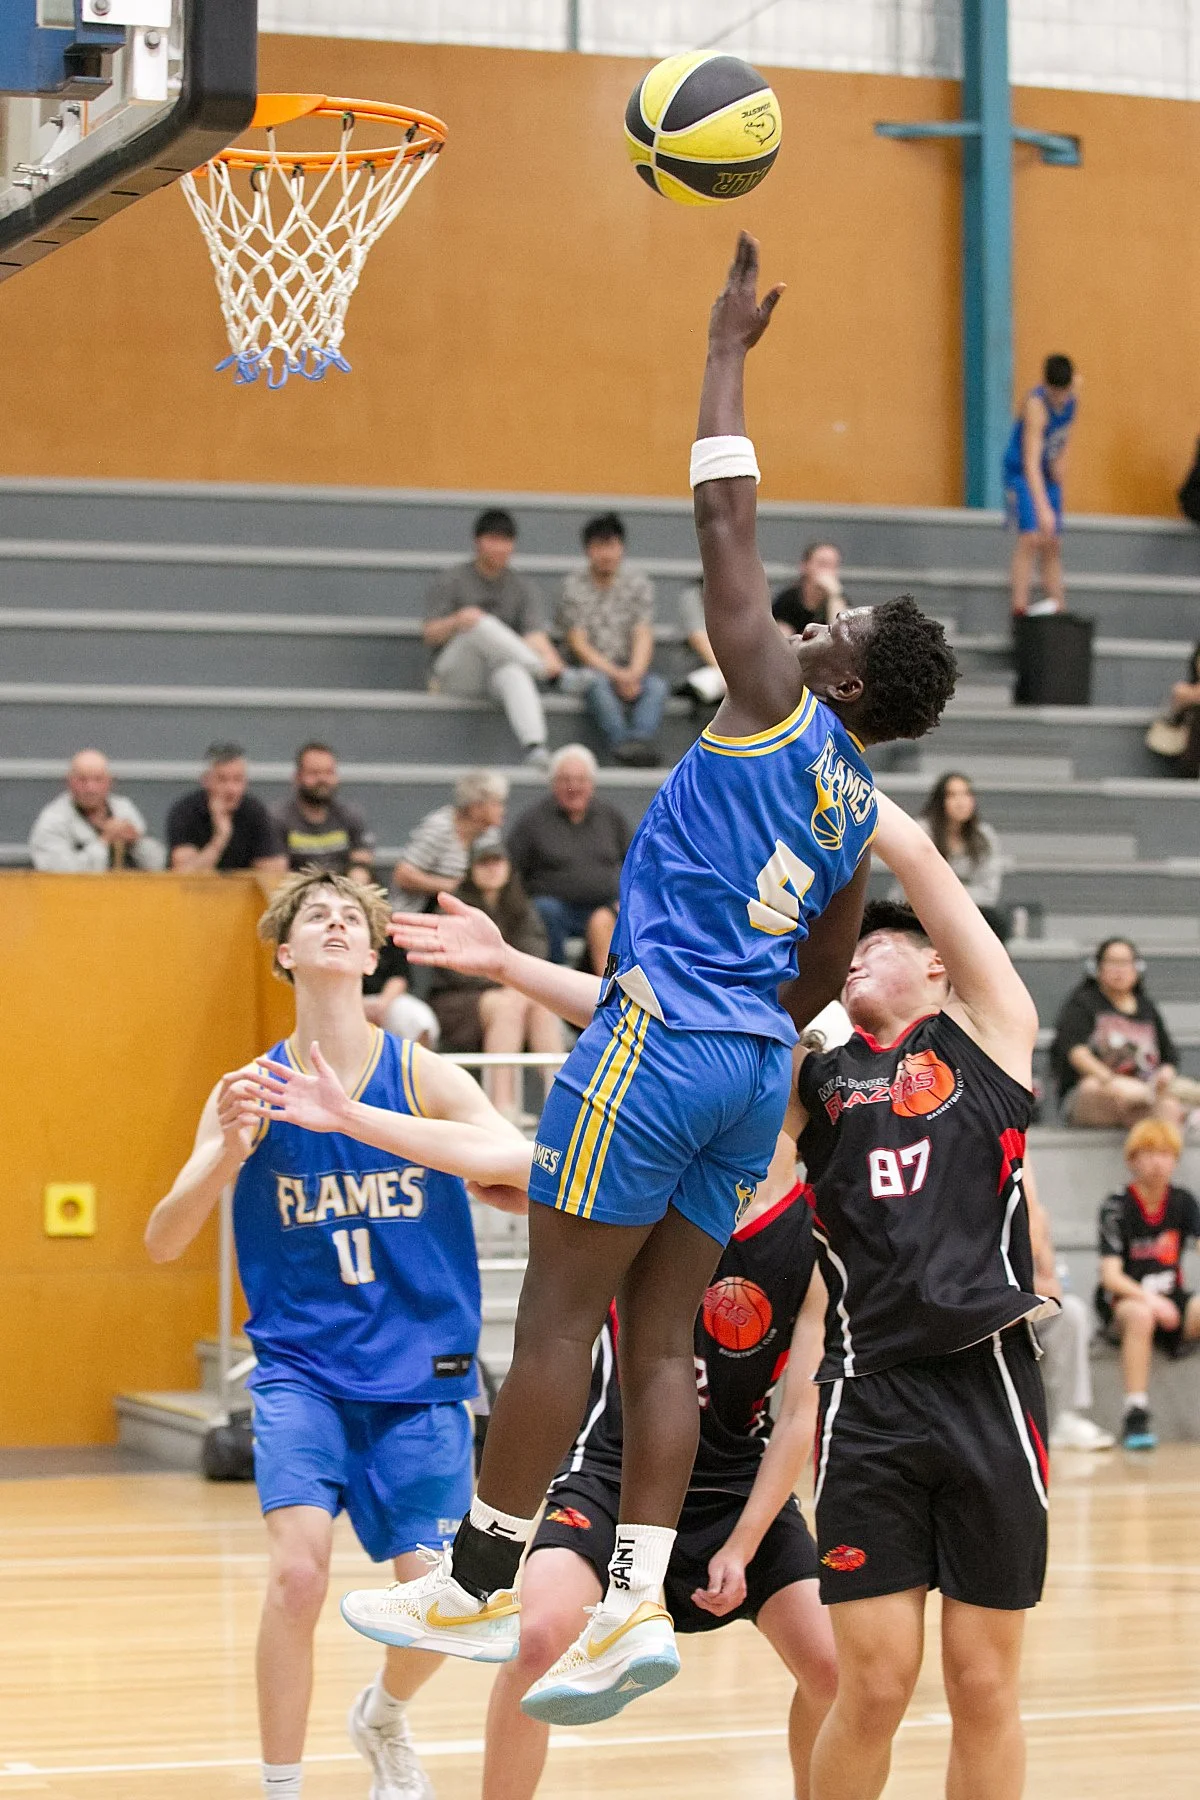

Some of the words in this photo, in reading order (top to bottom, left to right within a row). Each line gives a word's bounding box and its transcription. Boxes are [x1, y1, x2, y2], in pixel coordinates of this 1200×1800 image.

[805, 731, 876, 826] FLAMES
[274, 1165, 427, 1231] FLAMES
[867, 1136, 933, 1200] 87
[332, 1228, 376, 1286] 11
[610, 1535, 635, 1591] SAINT
